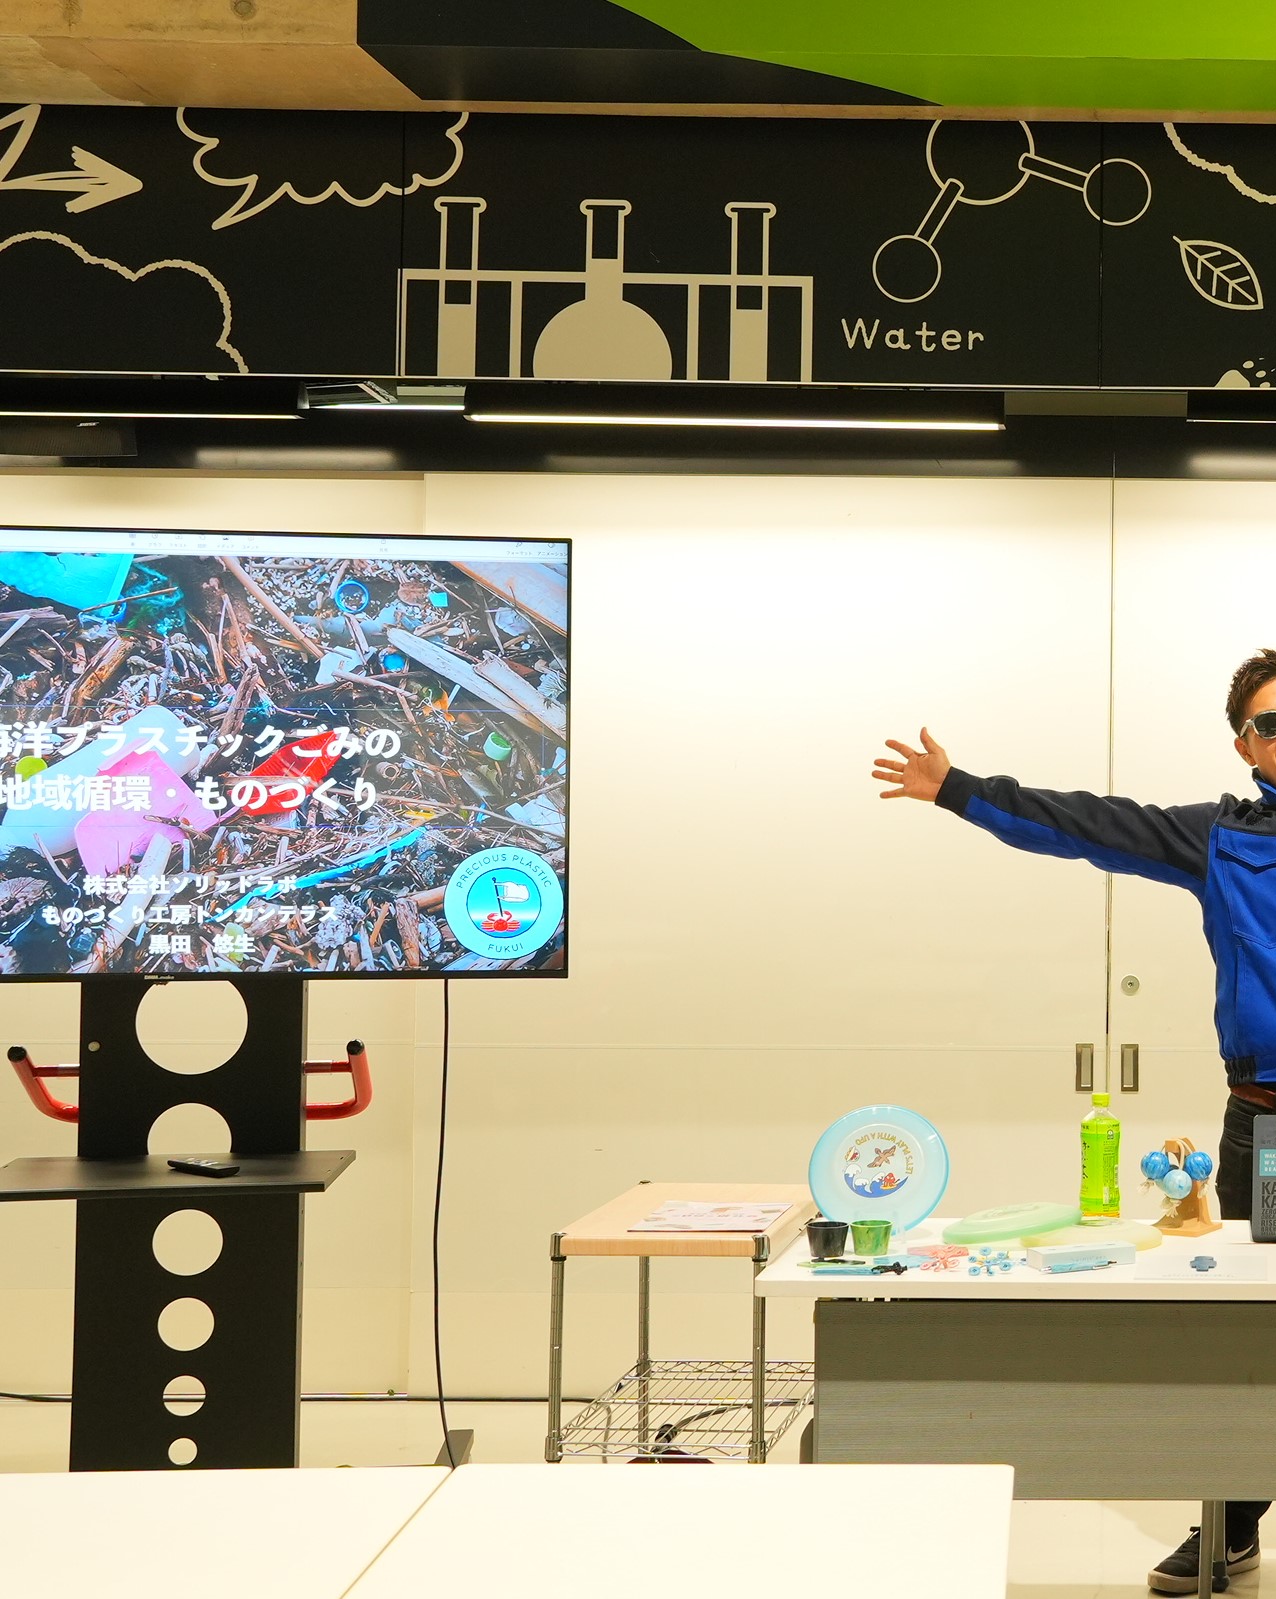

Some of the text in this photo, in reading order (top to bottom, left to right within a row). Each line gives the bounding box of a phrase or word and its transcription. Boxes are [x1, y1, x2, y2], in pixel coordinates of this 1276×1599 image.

[841, 318, 984, 352] Water
[0, 774, 377, 812] 地域循環・ものづくり
[456, 853, 552, 889] PRECIOUS PLASTIC
[83, 874, 298, 896] 株式会社ソリッドラボ
[42, 904, 338, 925] ものづくり工房トンカンテラス
[148, 934, 256, 954] 黒田 悠生
[487, 943, 524, 953] FUKUI
[855, 1135, 870, 1146] UFO
[877, 1132, 897, 1143] WITH
[896, 1140, 911, 1155] PLAY
